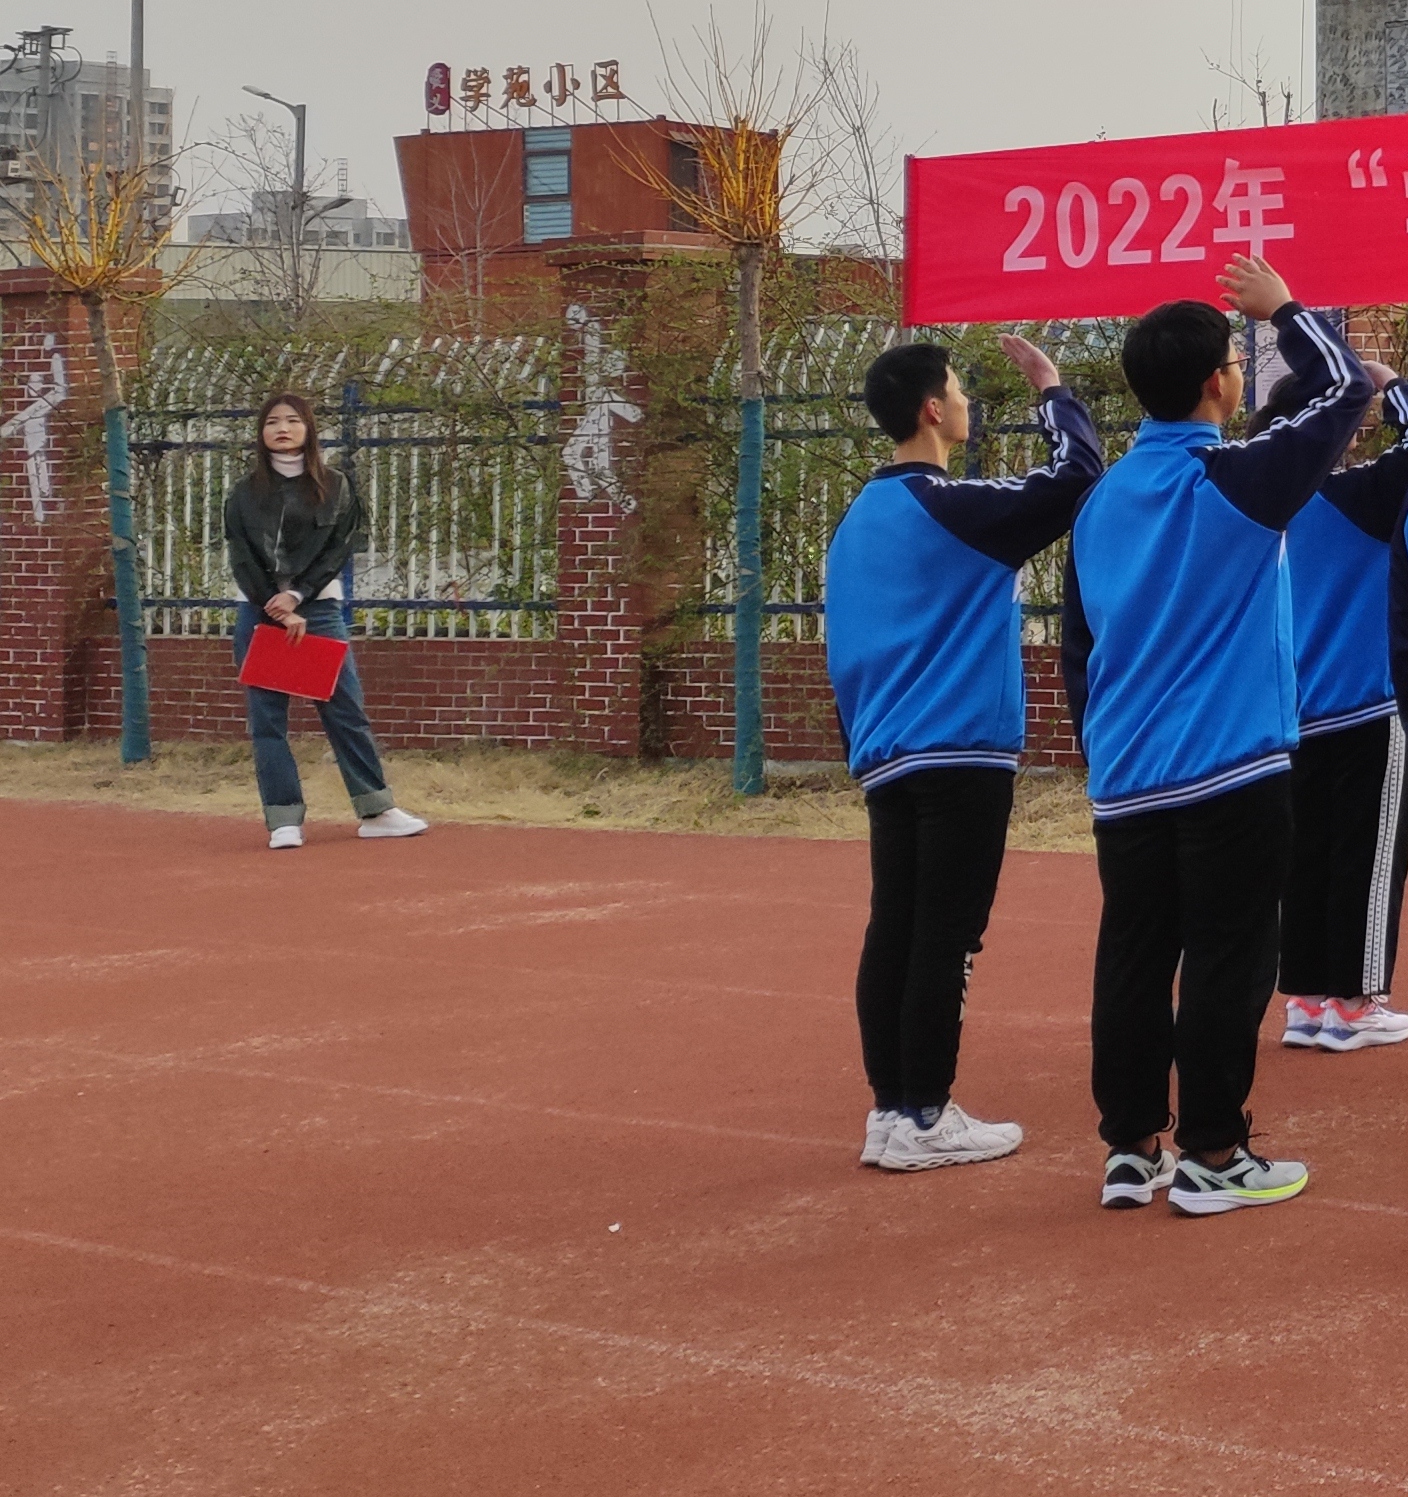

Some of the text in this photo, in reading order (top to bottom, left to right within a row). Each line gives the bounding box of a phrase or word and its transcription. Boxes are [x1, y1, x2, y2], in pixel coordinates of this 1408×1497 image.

[459, 59, 627, 112] 学苑小区
[1003, 157, 1294, 272] 2022年
